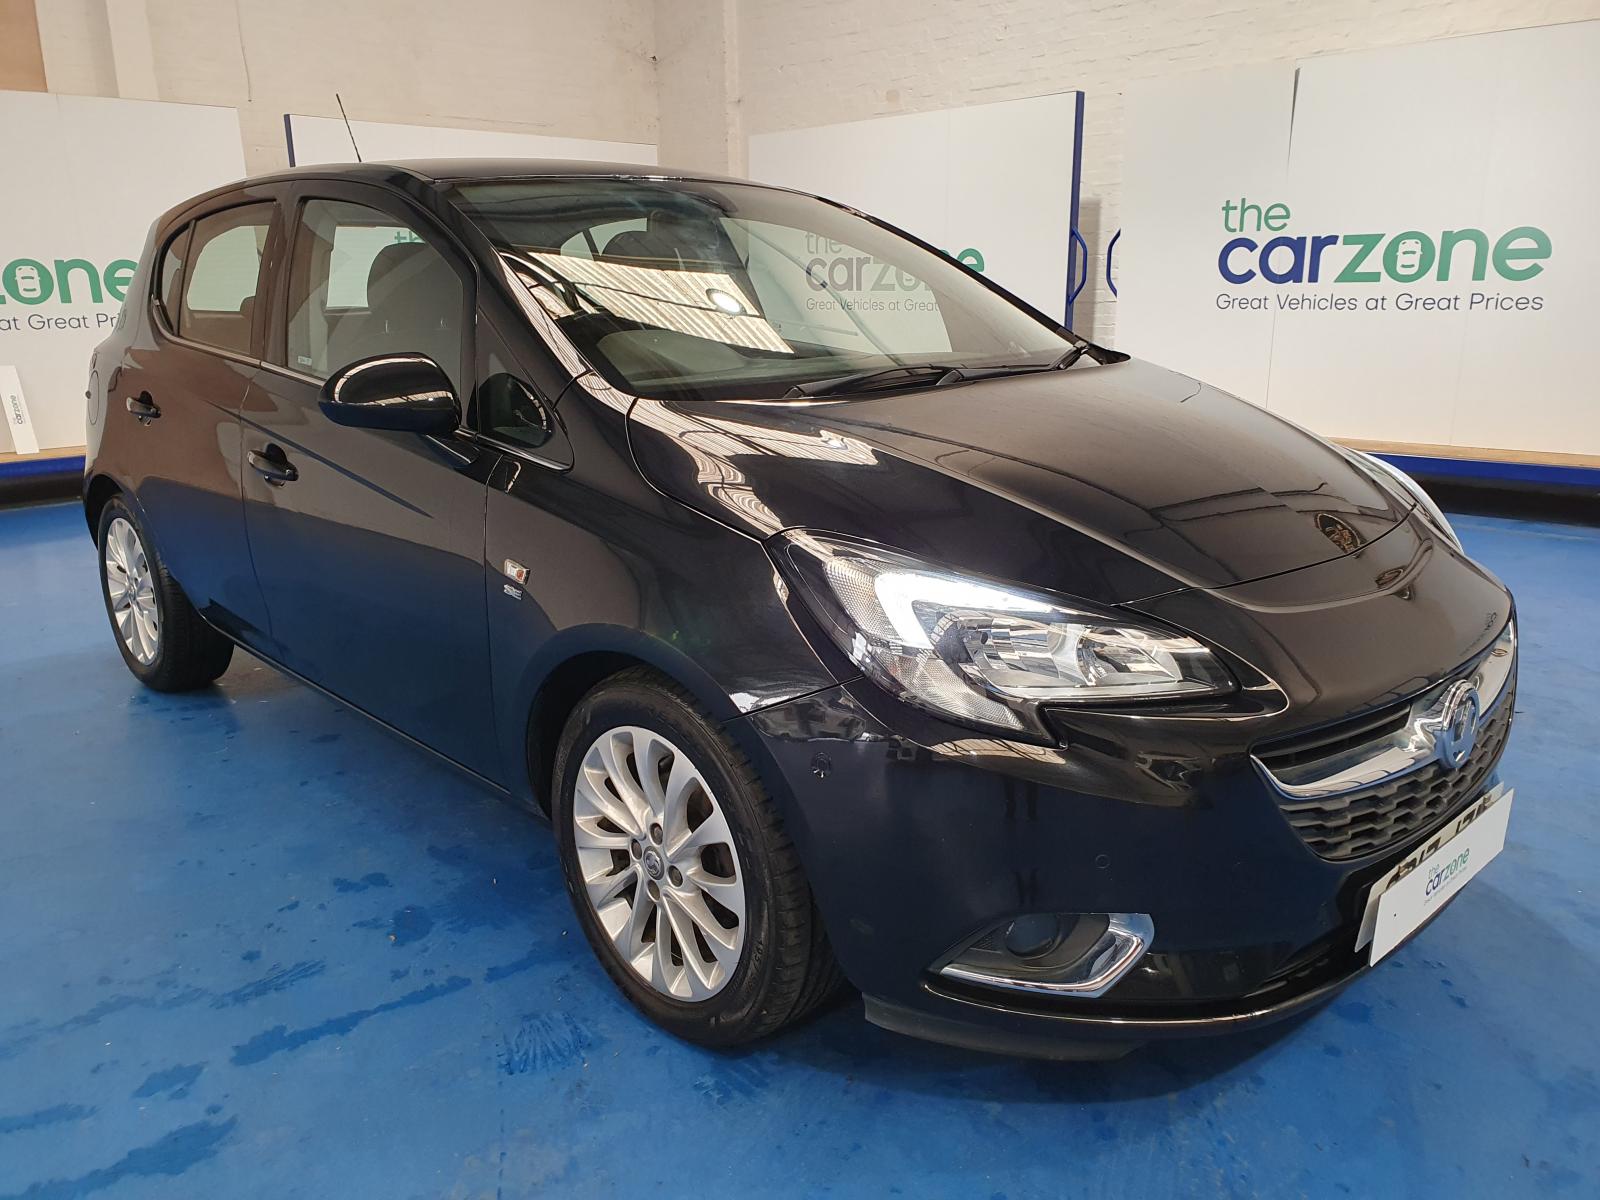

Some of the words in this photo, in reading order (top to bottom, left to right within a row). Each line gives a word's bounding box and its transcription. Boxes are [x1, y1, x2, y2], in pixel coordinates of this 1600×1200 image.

[1221, 198, 1291, 233] the
[1217, 226, 1553, 285] carzone
[0, 258, 141, 306] one
[806, 297, 836, 311] Great
[840, 297, 885, 311] Vehicles
[888, 299, 901, 312] at
[1215, 292, 1269, 311] Great
[1276, 292, 1358, 312] Vehicles
[1365, 294, 1387, 311] at
[1395, 292, 1460, 312] Great
[1469, 292, 1545, 312] Prices
[28, 313, 90, 330] Great
[1425, 847, 1470, 896] carzone
